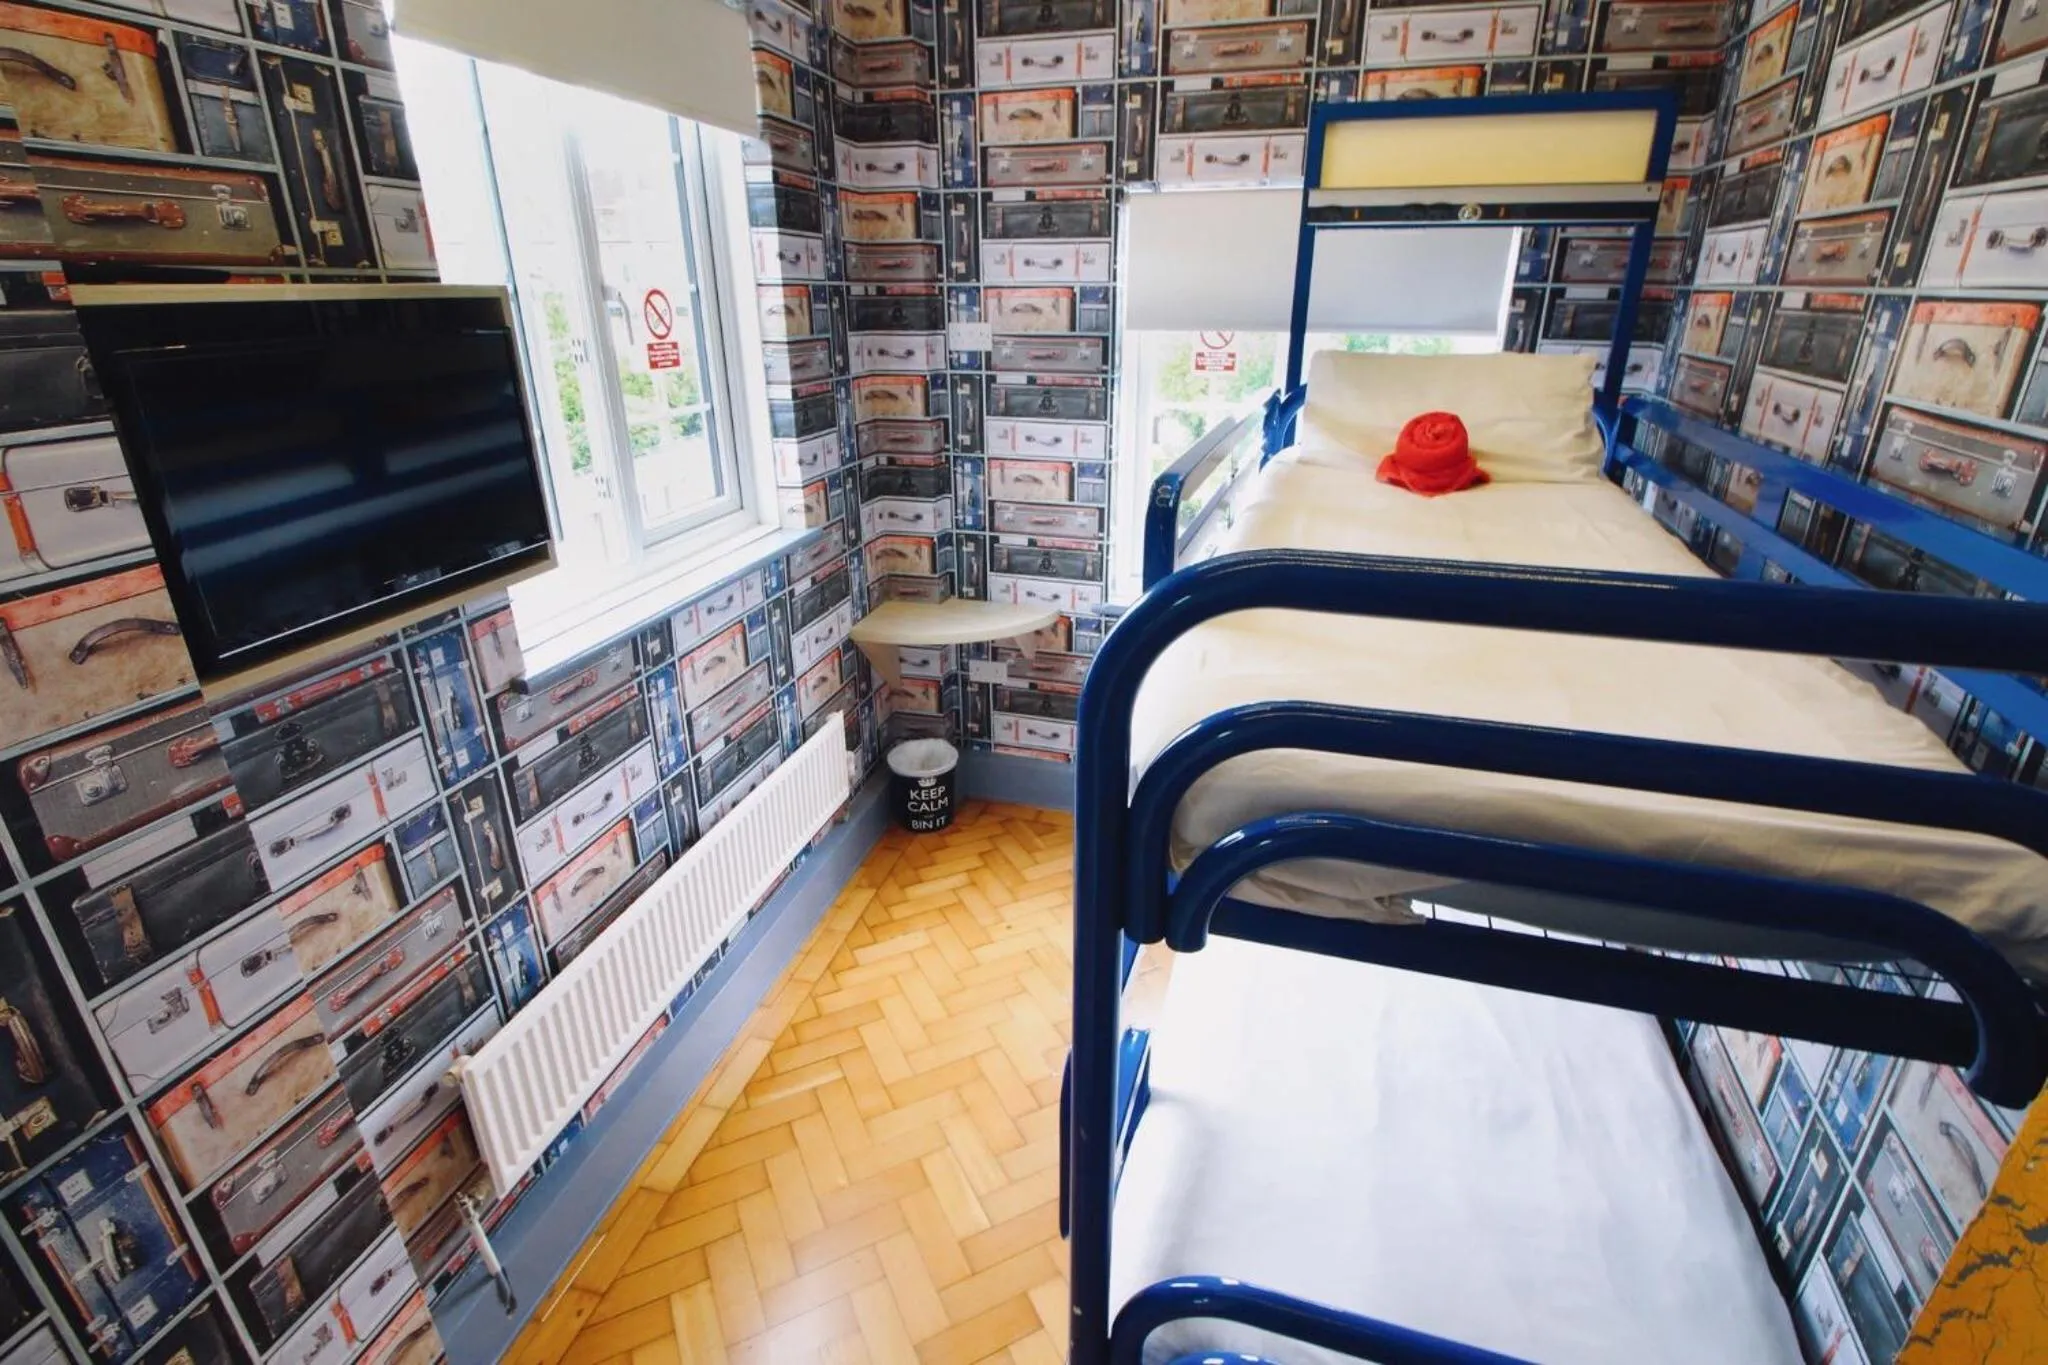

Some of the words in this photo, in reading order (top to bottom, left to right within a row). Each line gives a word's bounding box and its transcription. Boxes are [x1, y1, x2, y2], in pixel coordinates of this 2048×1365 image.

[910, 786, 946, 800] KEEP
[907, 797, 949, 812] CALM
[911, 819, 933, 829] BIN
[936, 815, 946, 827] IT
